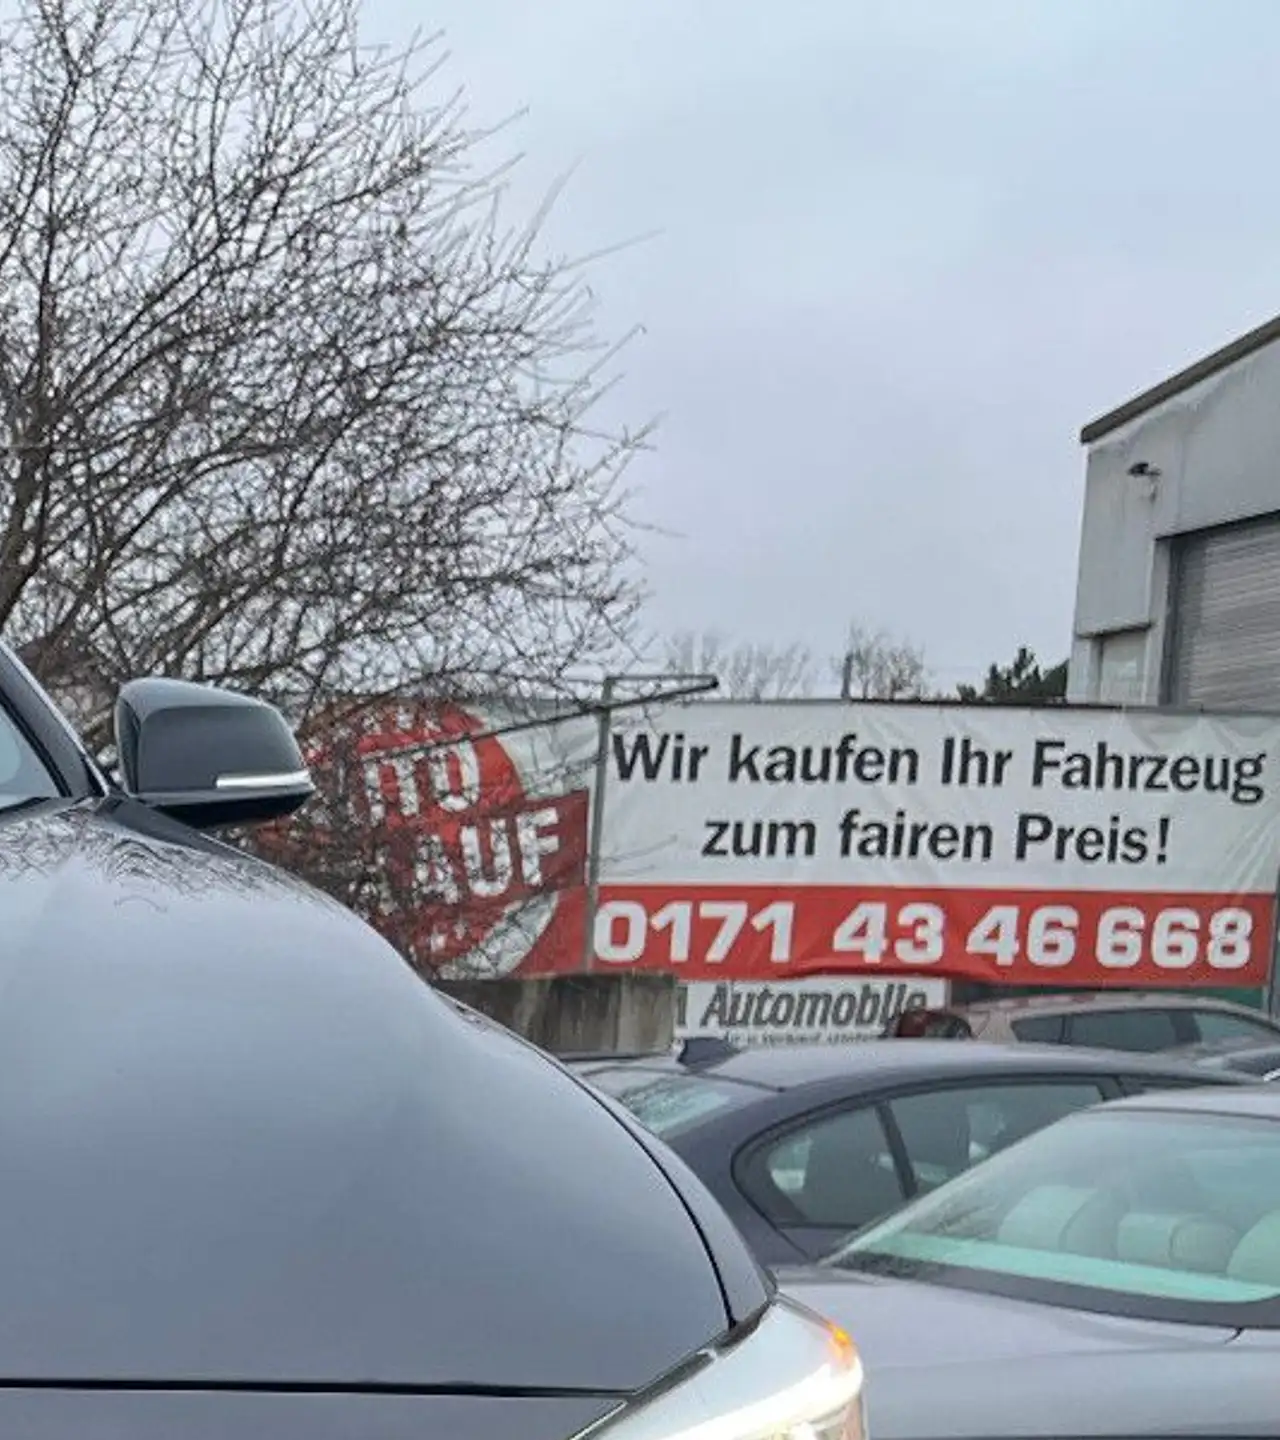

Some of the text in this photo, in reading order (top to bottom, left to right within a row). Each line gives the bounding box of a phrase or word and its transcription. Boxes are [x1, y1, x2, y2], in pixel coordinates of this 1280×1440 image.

[612, 734, 1267, 804] Wir kaufen Ihr Fahrzeug
[701, 809, 1171, 865] zum fairen Preis!
[593, 900, 1254, 970] 0171 43 46 668
